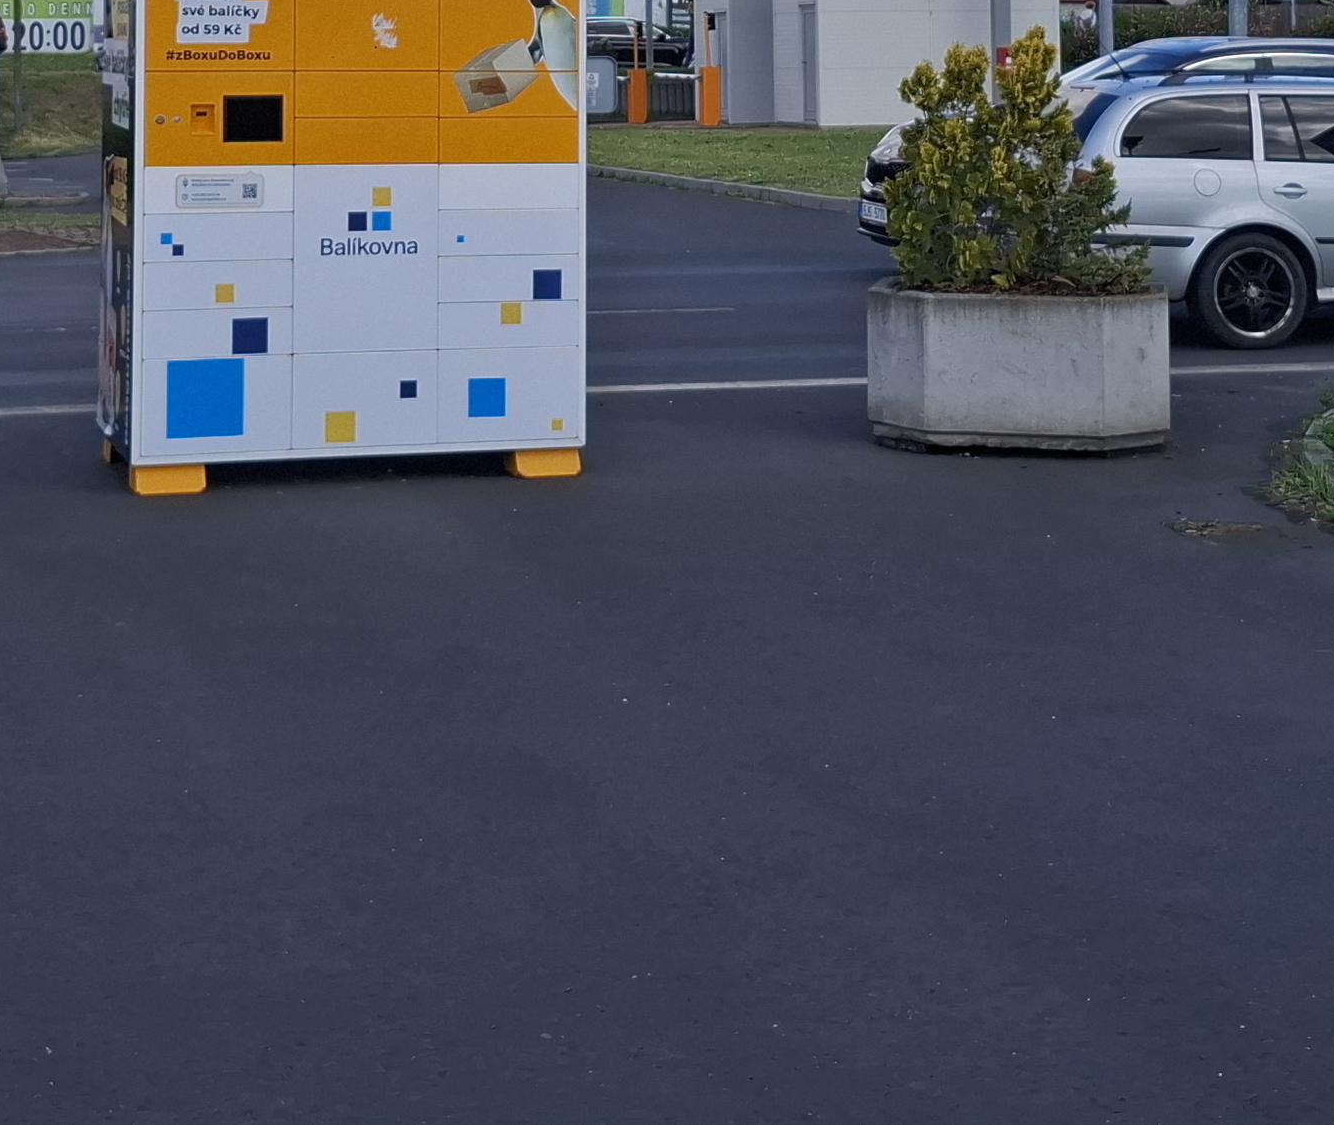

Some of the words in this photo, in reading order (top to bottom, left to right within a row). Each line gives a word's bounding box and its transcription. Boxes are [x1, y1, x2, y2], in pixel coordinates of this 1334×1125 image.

[181, 4, 205, 17] své
[208, 4, 260, 20] balíčky
[181, 24, 200, 36] od
[203, 24, 220, 36] 59
[224, 24, 243, 36] Kč
[166, 50, 272, 62] #zBoxuDoBoxu
[320, 237, 418, 257] Balíkovna
